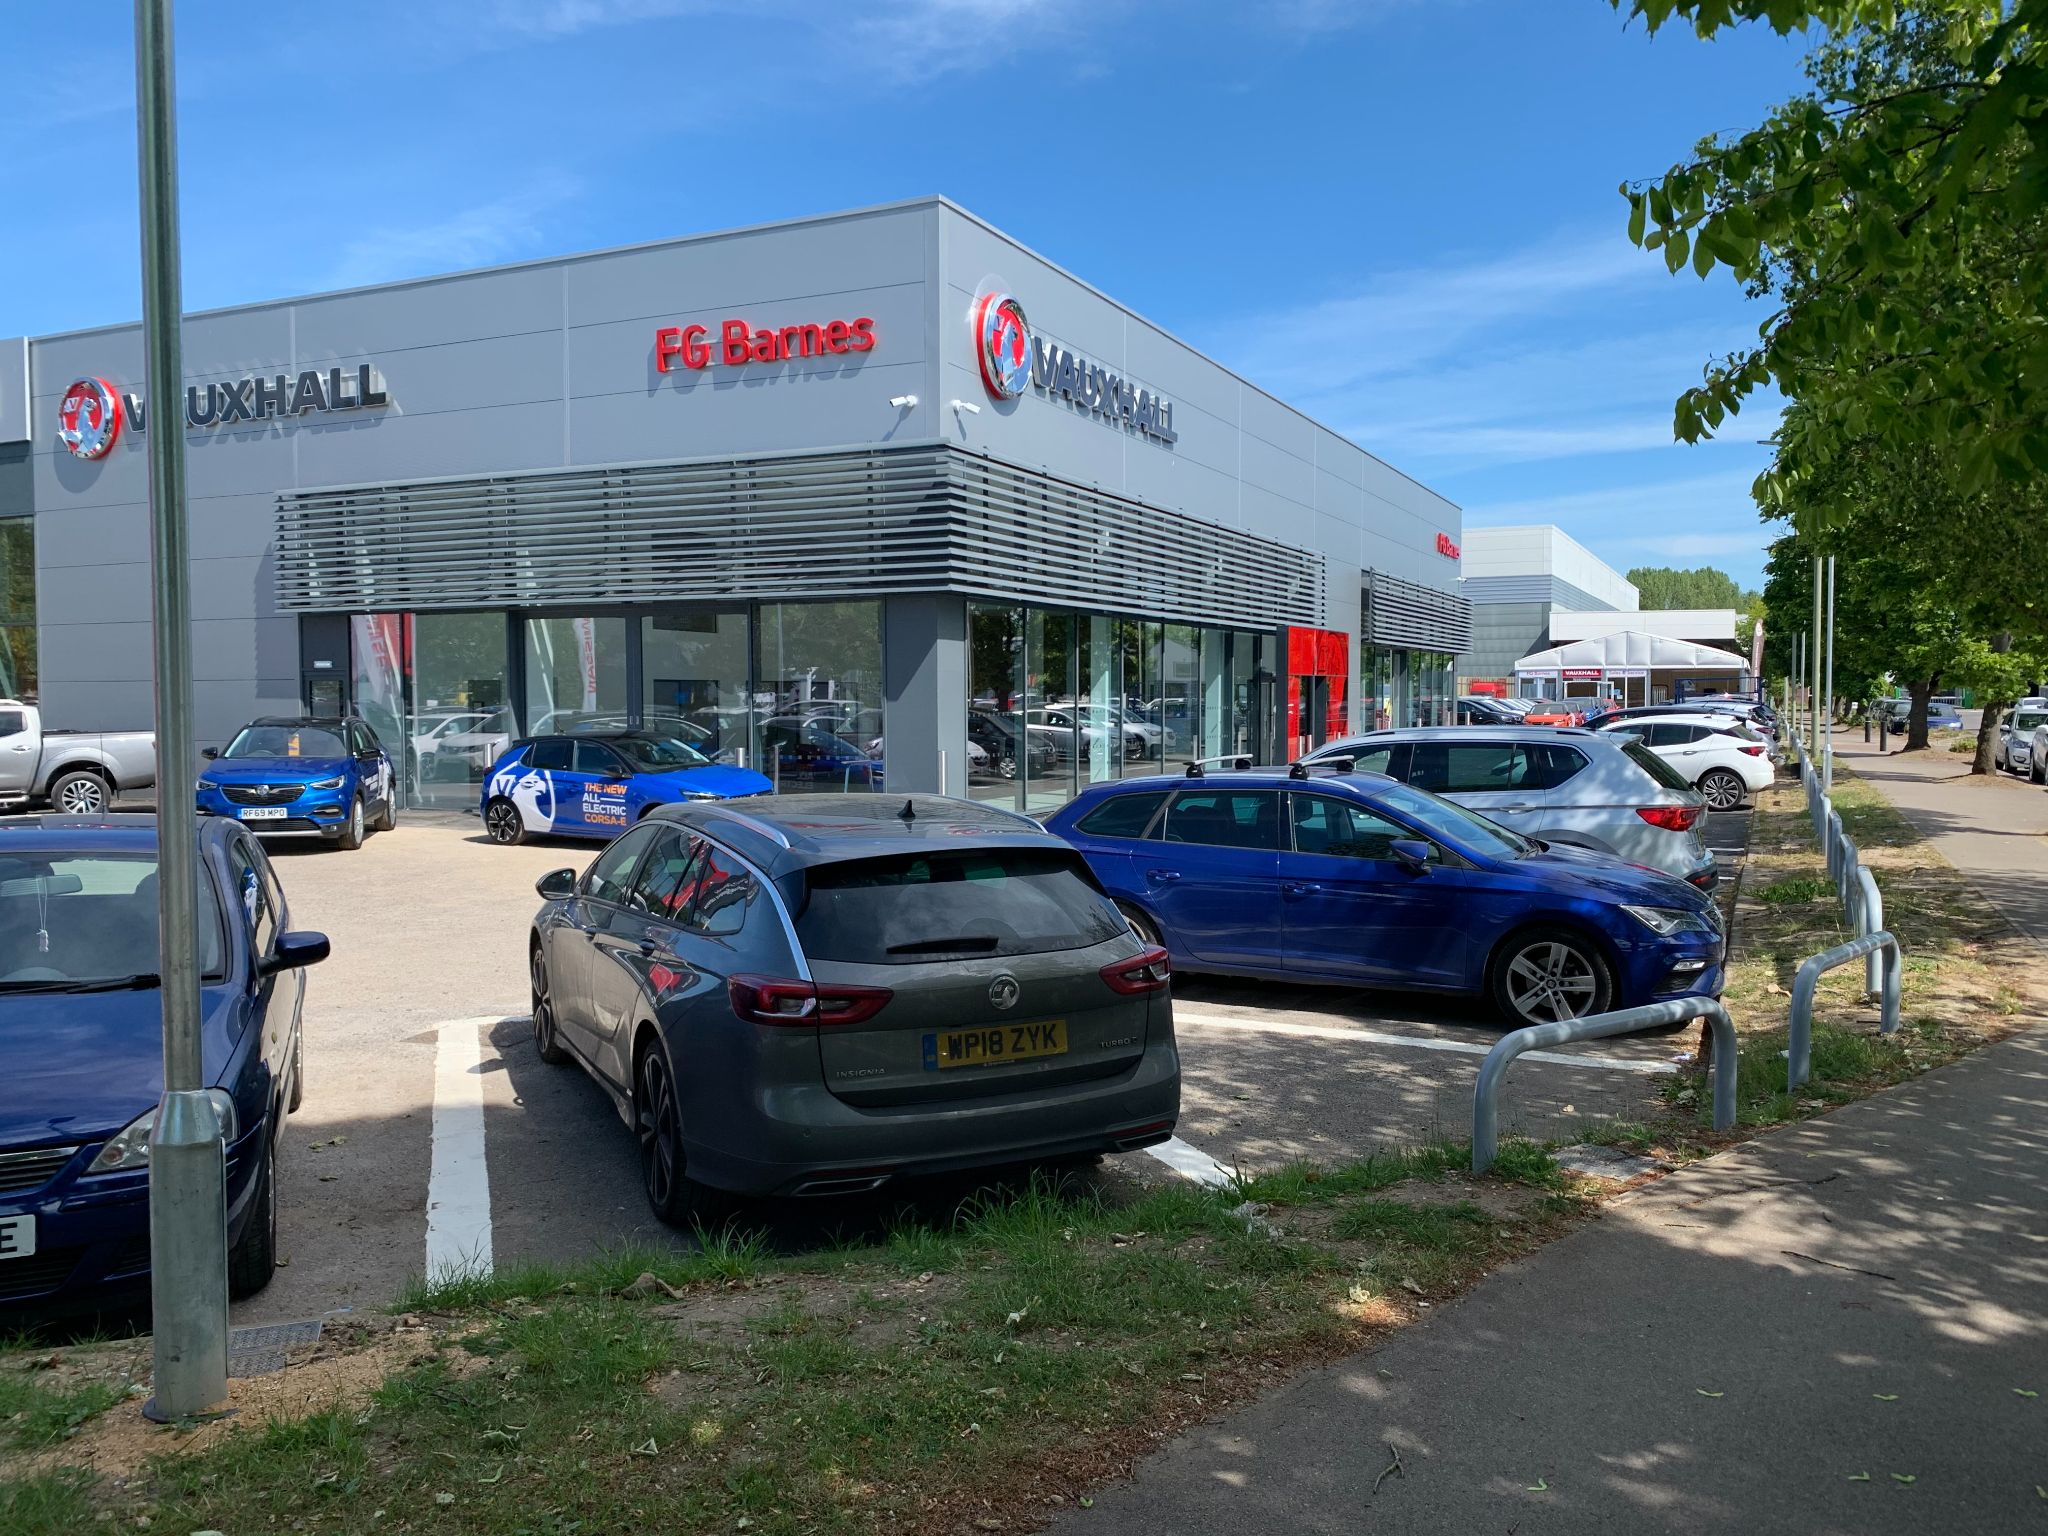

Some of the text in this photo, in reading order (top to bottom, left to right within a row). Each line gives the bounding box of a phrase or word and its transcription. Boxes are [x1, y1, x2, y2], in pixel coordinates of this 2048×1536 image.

[655, 316, 876, 373] FG Barnes
[1031, 335, 1178, 443] VAUXHALL
[122, 363, 387, 433] VUXHALL
[584, 782, 628, 795] THE NEW
[582, 792, 600, 803] ALL
[243, 809, 266, 817] RF69
[582, 803, 627, 816] ELECTRIC
[584, 813, 627, 826] CORSA-E
[947, 1023, 1058, 1061] WP18 ZYK
[836, 1068, 886, 1078] INSIGNIA
